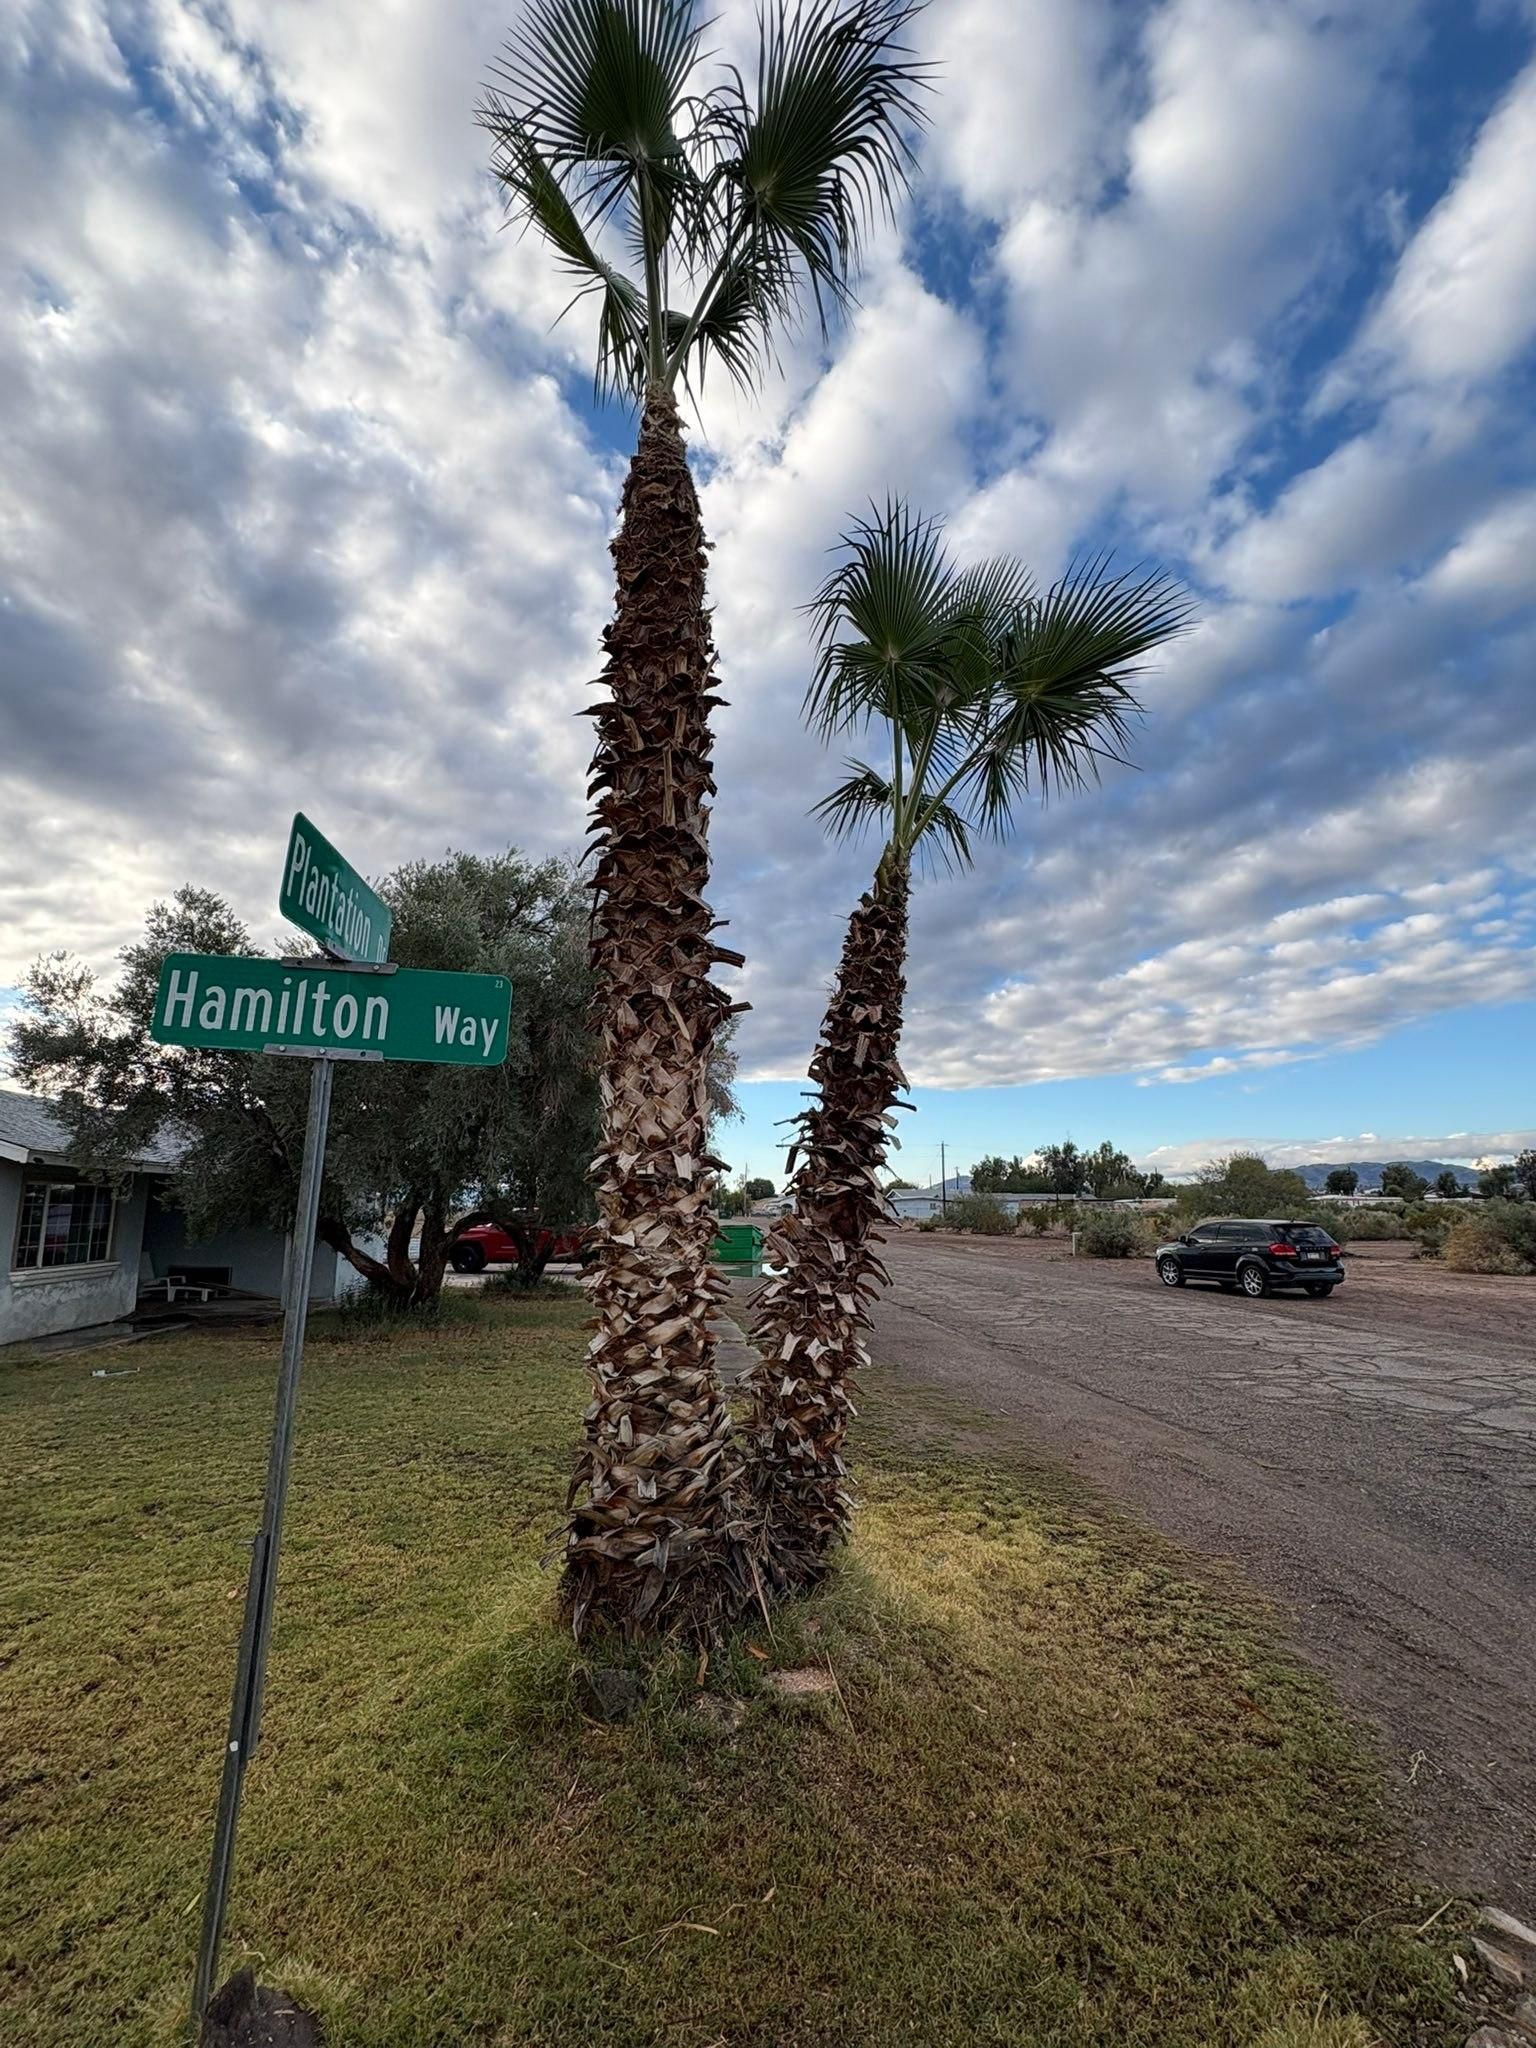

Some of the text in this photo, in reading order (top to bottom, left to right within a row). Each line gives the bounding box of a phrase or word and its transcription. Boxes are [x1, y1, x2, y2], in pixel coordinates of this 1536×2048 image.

[286, 832, 371, 958] Plantation
[162, 969, 499, 1057] Hamilton Way
